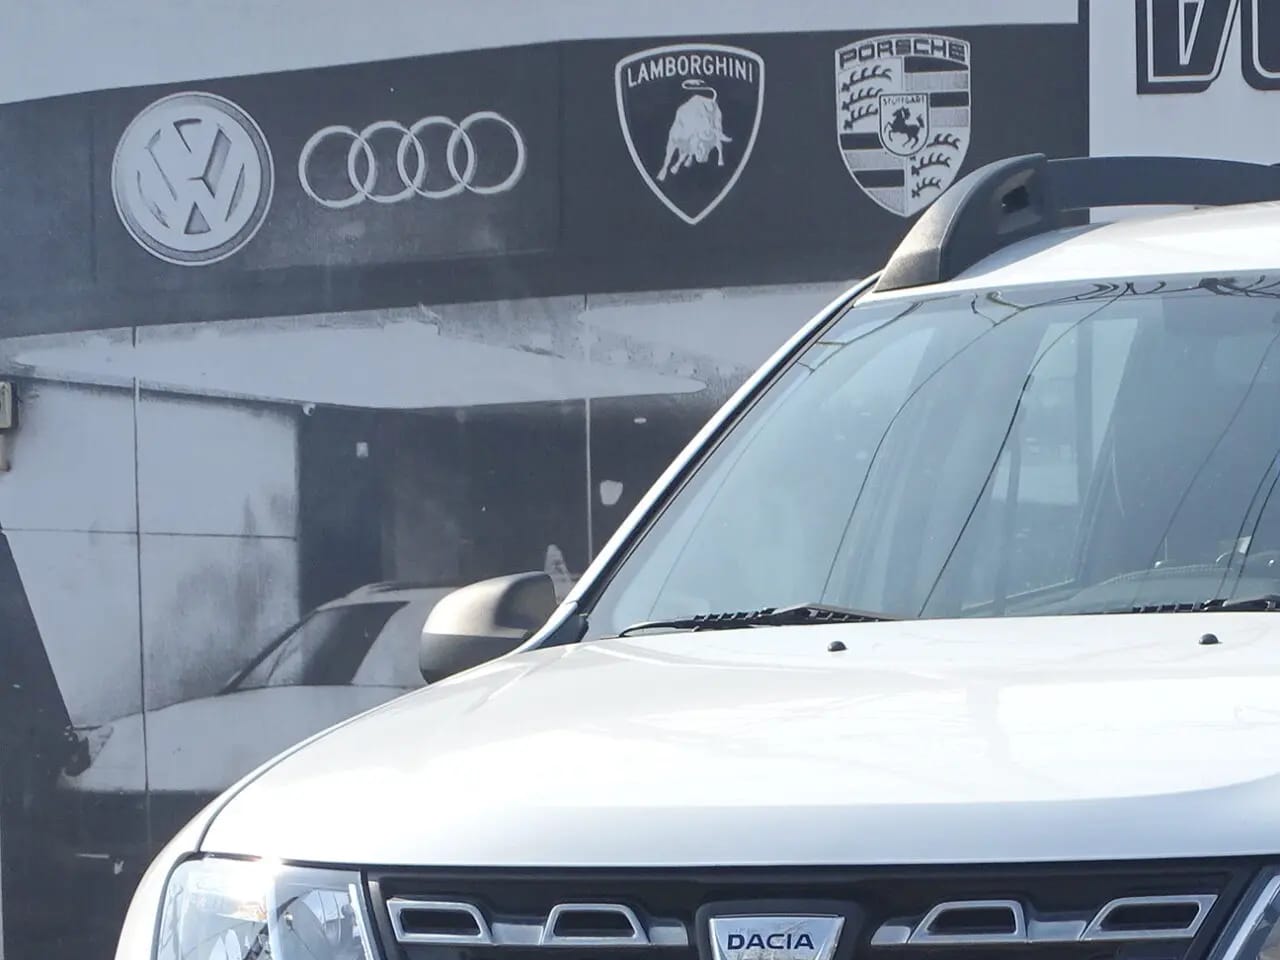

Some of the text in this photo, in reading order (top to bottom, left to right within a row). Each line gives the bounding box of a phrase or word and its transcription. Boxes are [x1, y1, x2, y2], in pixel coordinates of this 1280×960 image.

[839, 38, 967, 68] PORSCHE
[627, 54, 753, 87] LAMBORGHINI
[727, 933, 815, 950] DACIA
